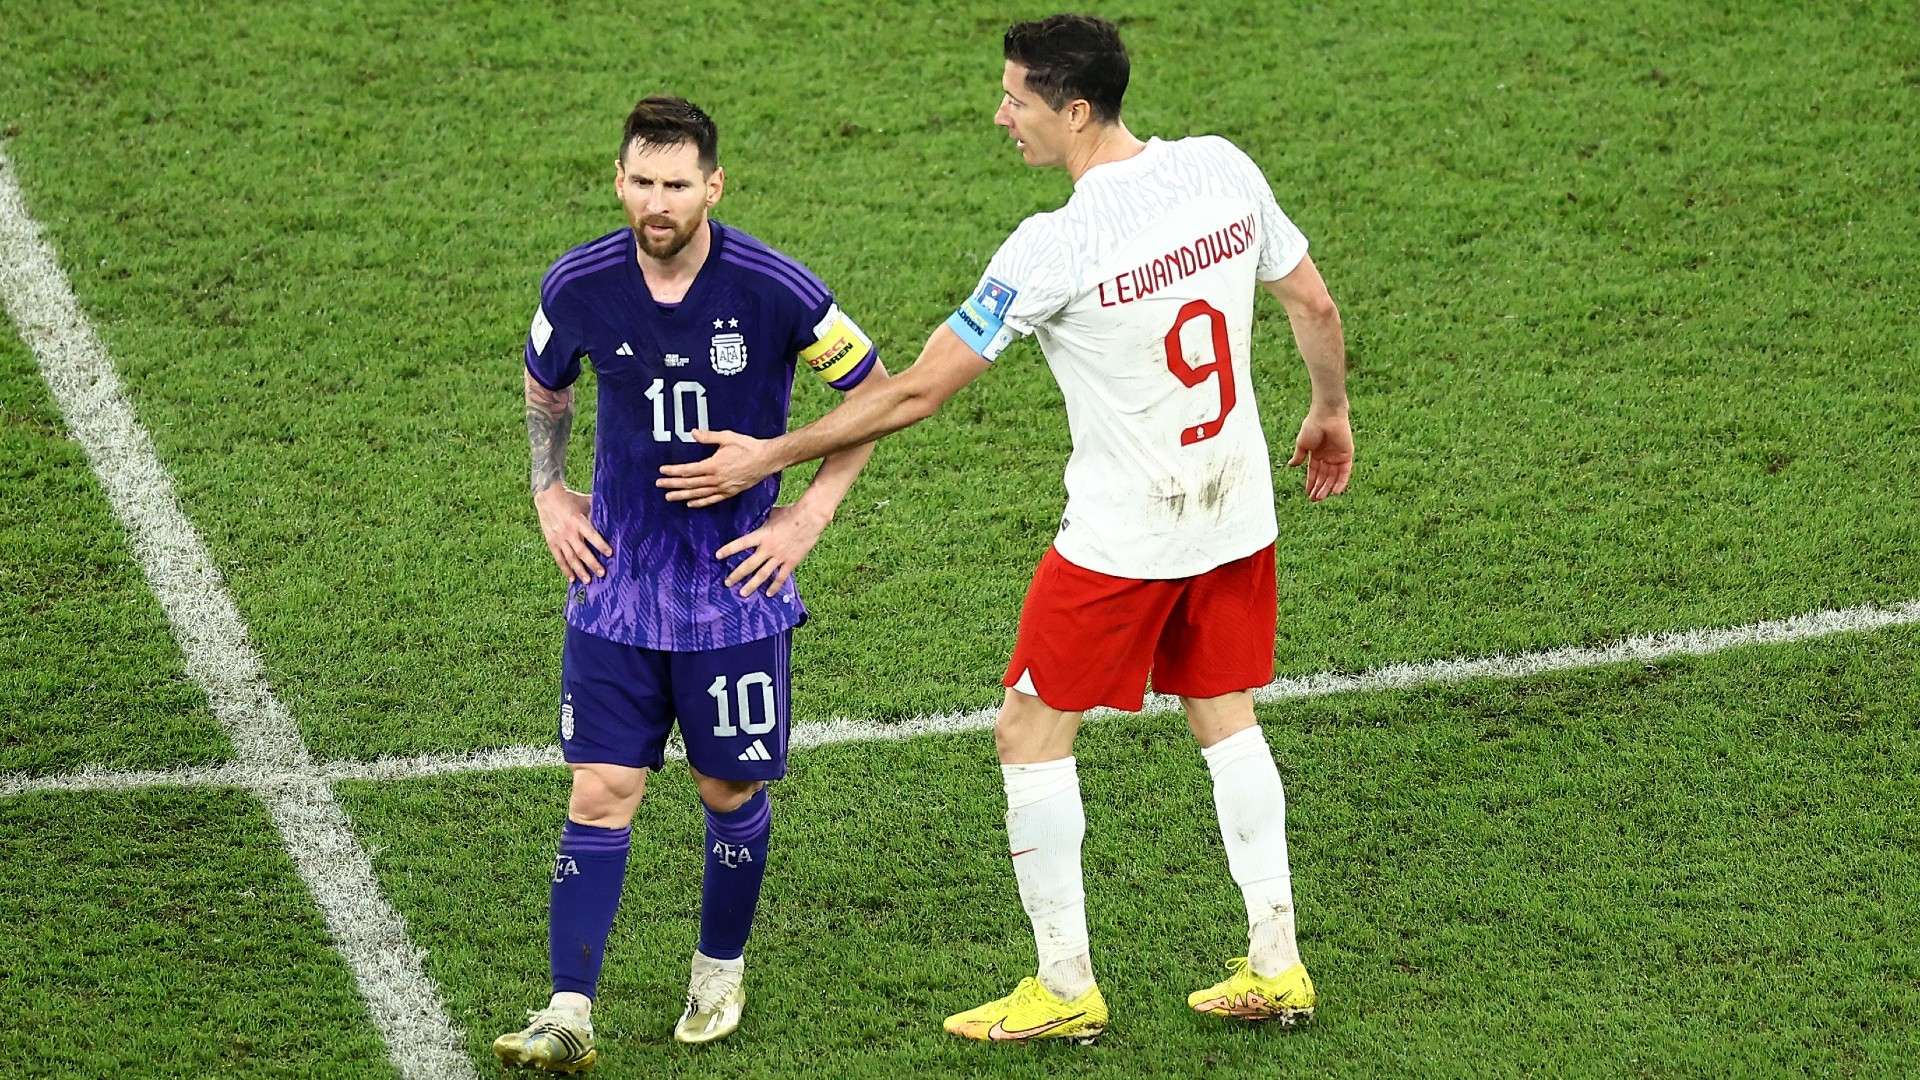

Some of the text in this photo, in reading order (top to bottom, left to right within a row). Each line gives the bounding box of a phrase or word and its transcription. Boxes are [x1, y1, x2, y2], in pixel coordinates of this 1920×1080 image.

[1098, 212, 1256, 308] LEWANDOWSKI
[643, 378, 709, 443] 10
[1164, 299, 1237, 447] 9
[707, 671, 776, 737] 10
